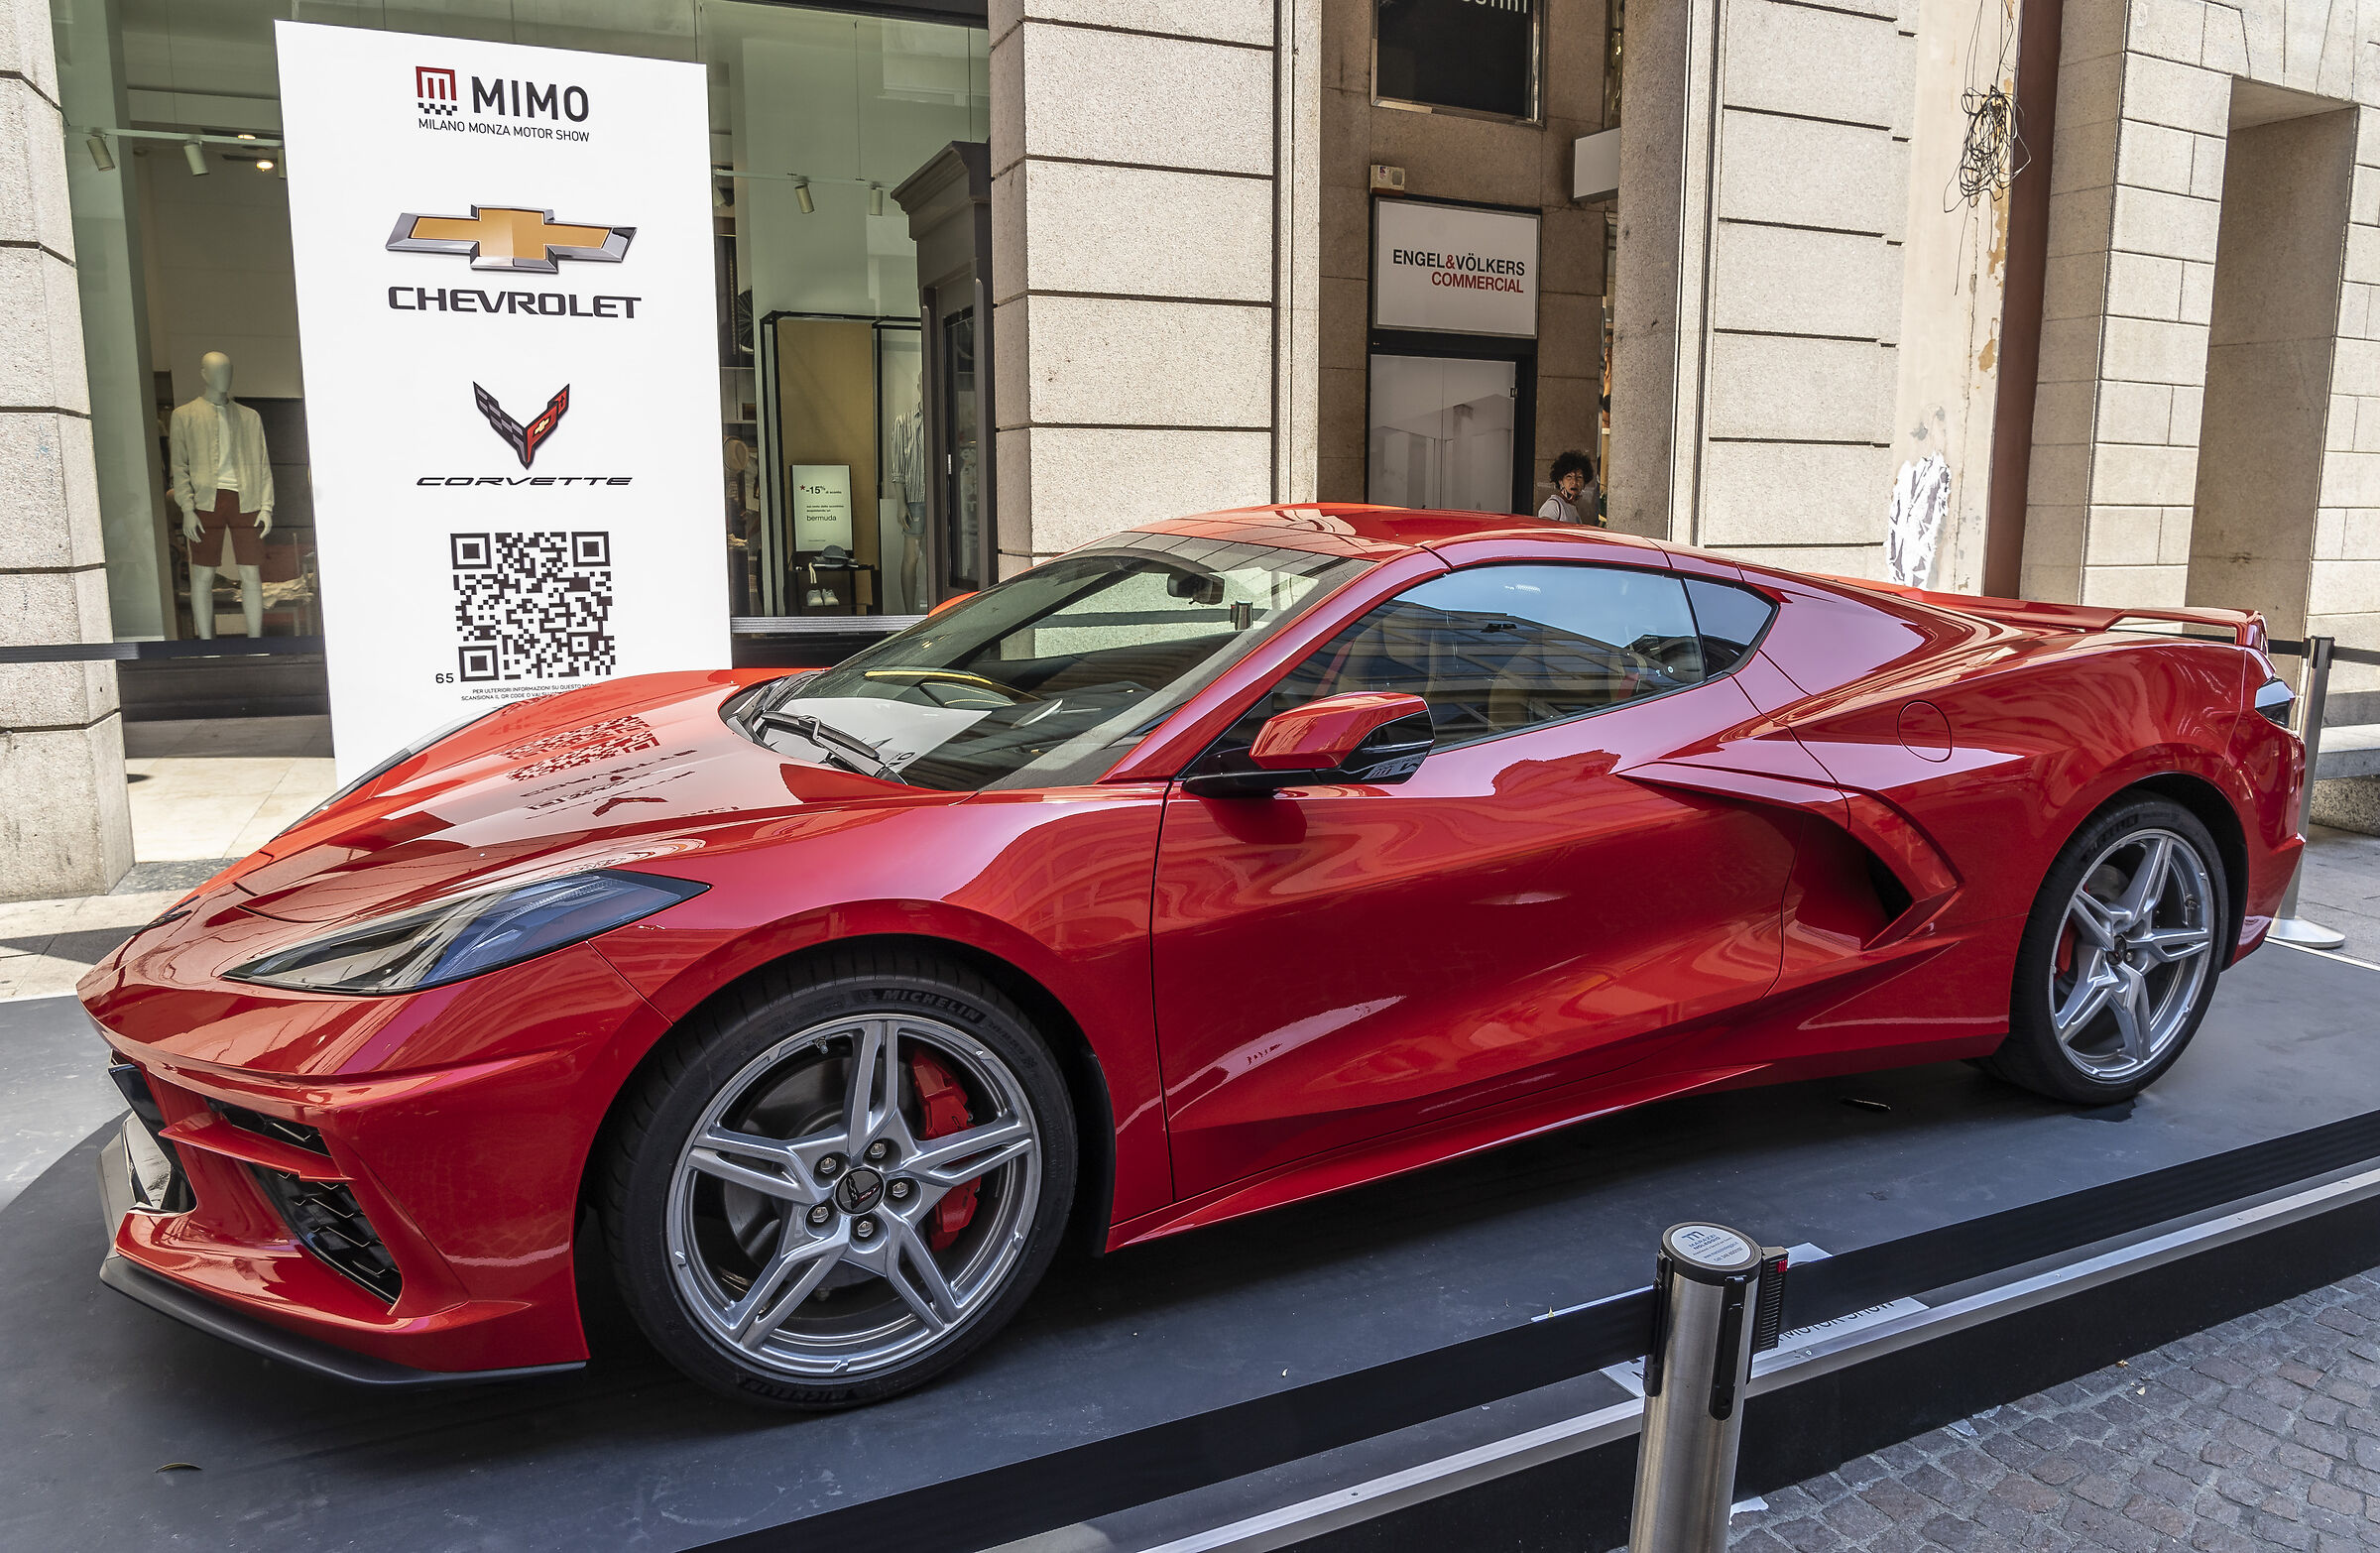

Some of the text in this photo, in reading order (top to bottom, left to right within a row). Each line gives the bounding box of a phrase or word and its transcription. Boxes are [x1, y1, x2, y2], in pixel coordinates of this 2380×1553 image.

[472, 76, 589, 122] MIMO
[418, 118, 589, 142] MILANO MONZA MOTOR SHOW
[1393, 249, 1525, 276] ENGEL&VÖLKERS
[1432, 272, 1523, 294] COMMERCIAL
[389, 287, 642, 318] CHEVROLET
[416, 477, 633, 486] CORVETTE
[435, 673, 453, 684] 65
[882, 990, 981, 1020] MICHELIN
